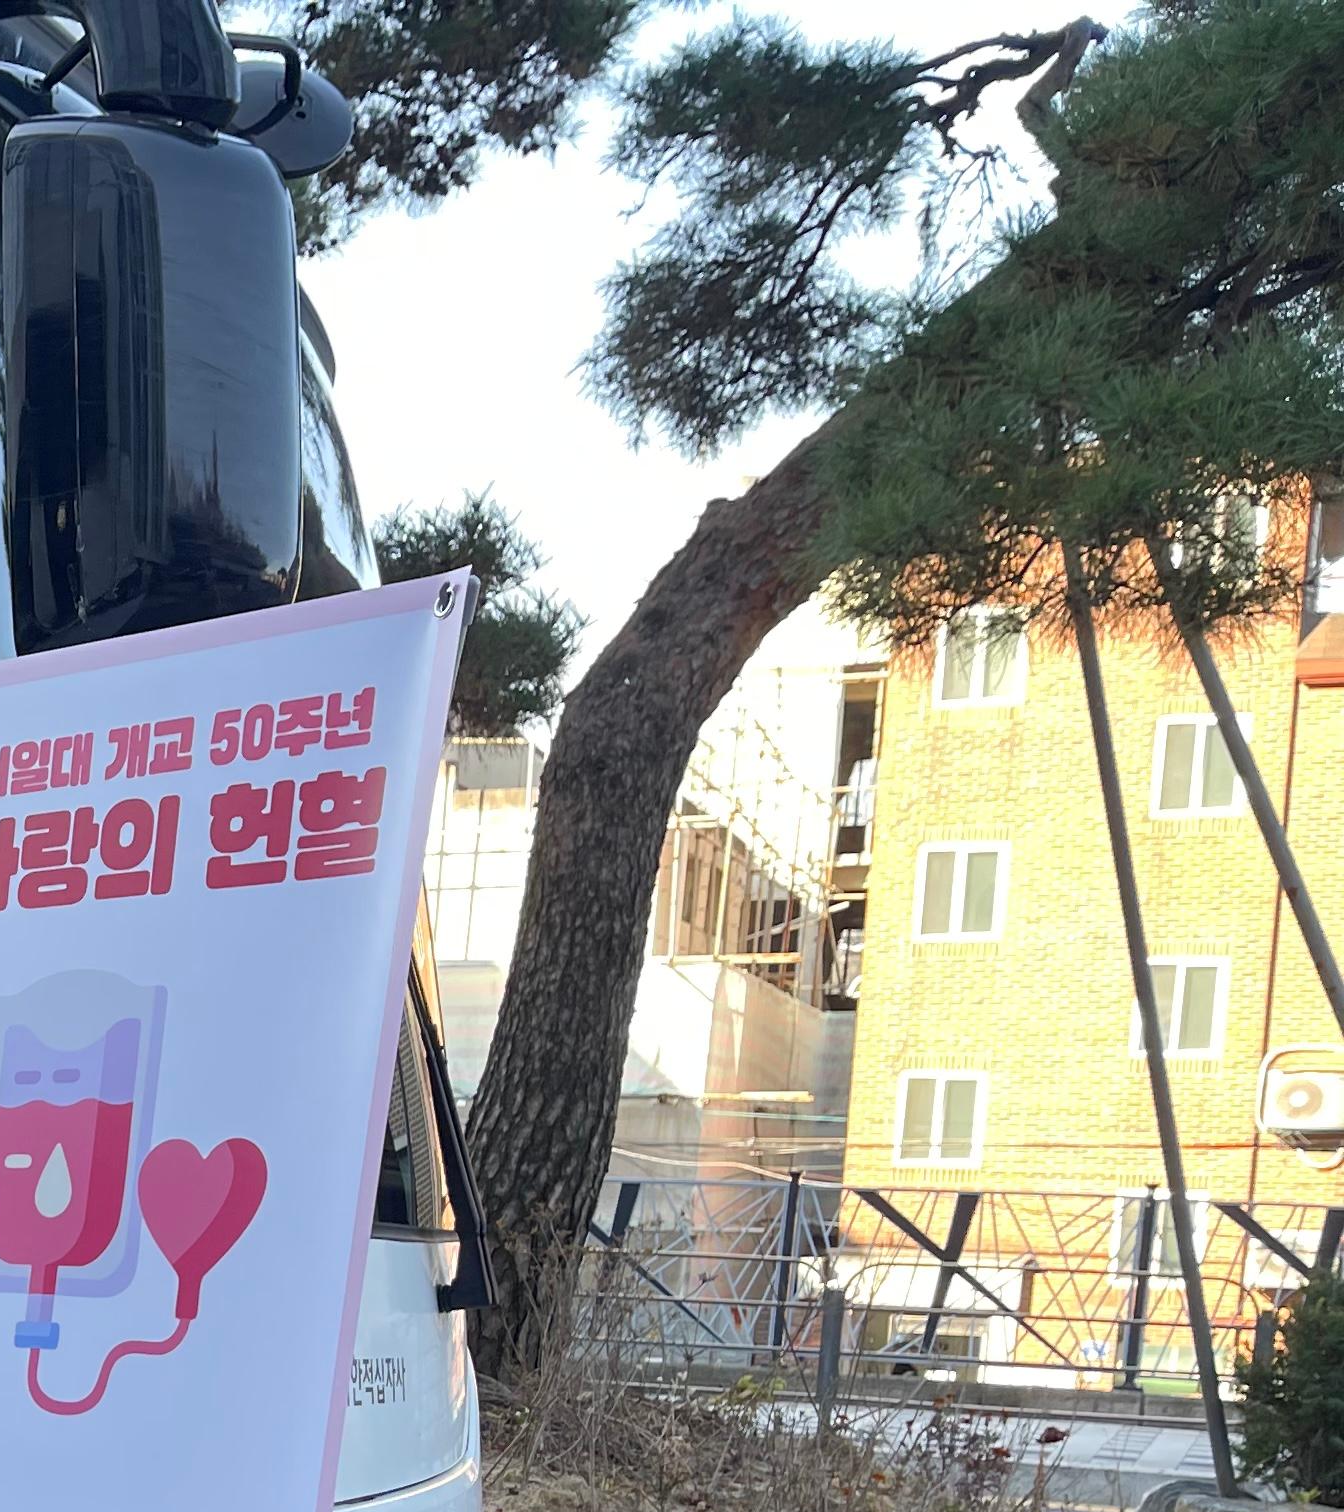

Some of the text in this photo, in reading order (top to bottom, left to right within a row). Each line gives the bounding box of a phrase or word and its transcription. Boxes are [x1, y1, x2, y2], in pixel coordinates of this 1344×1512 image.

[104, 716, 195, 781] 개교
[209, 686, 376, 766] 50주년
[206, 766, 387, 889] 헌혈
[347, 1355, 406, 1407] 한적십자사
